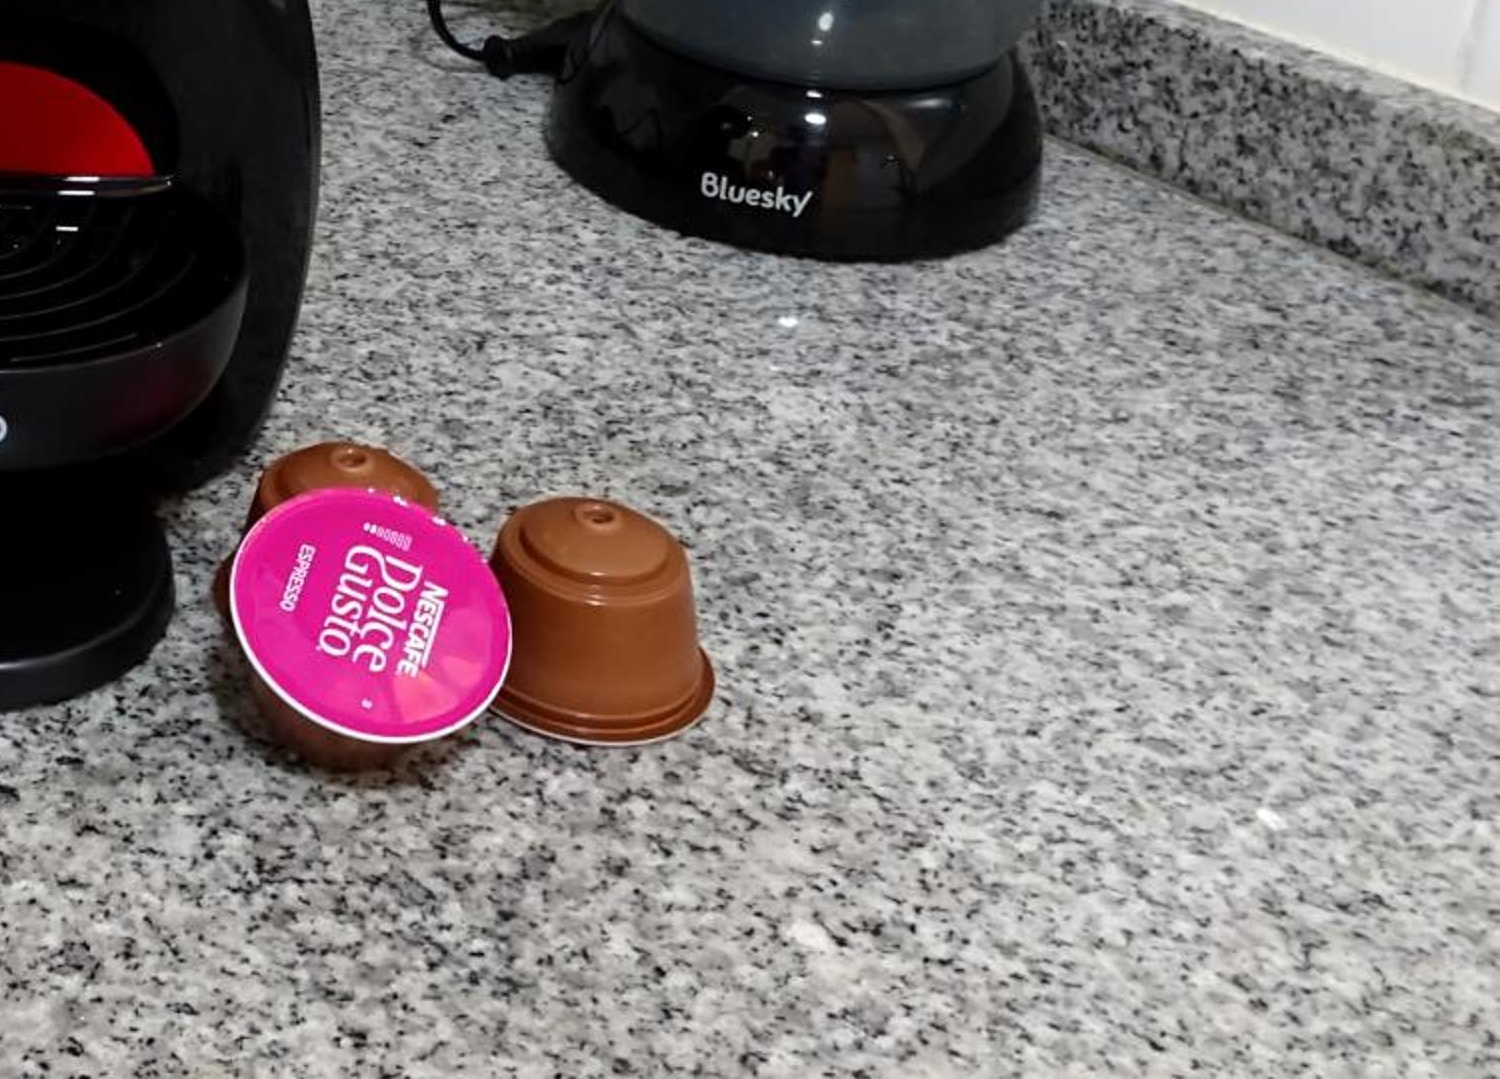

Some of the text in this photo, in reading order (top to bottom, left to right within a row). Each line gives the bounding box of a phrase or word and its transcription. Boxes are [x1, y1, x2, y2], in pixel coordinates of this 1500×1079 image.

[701, 171, 813, 218] Bluesky
[279, 544, 316, 612] ESPRESSO
[319, 545, 386, 657] Gusto
[352, 555, 422, 672] Dolce
